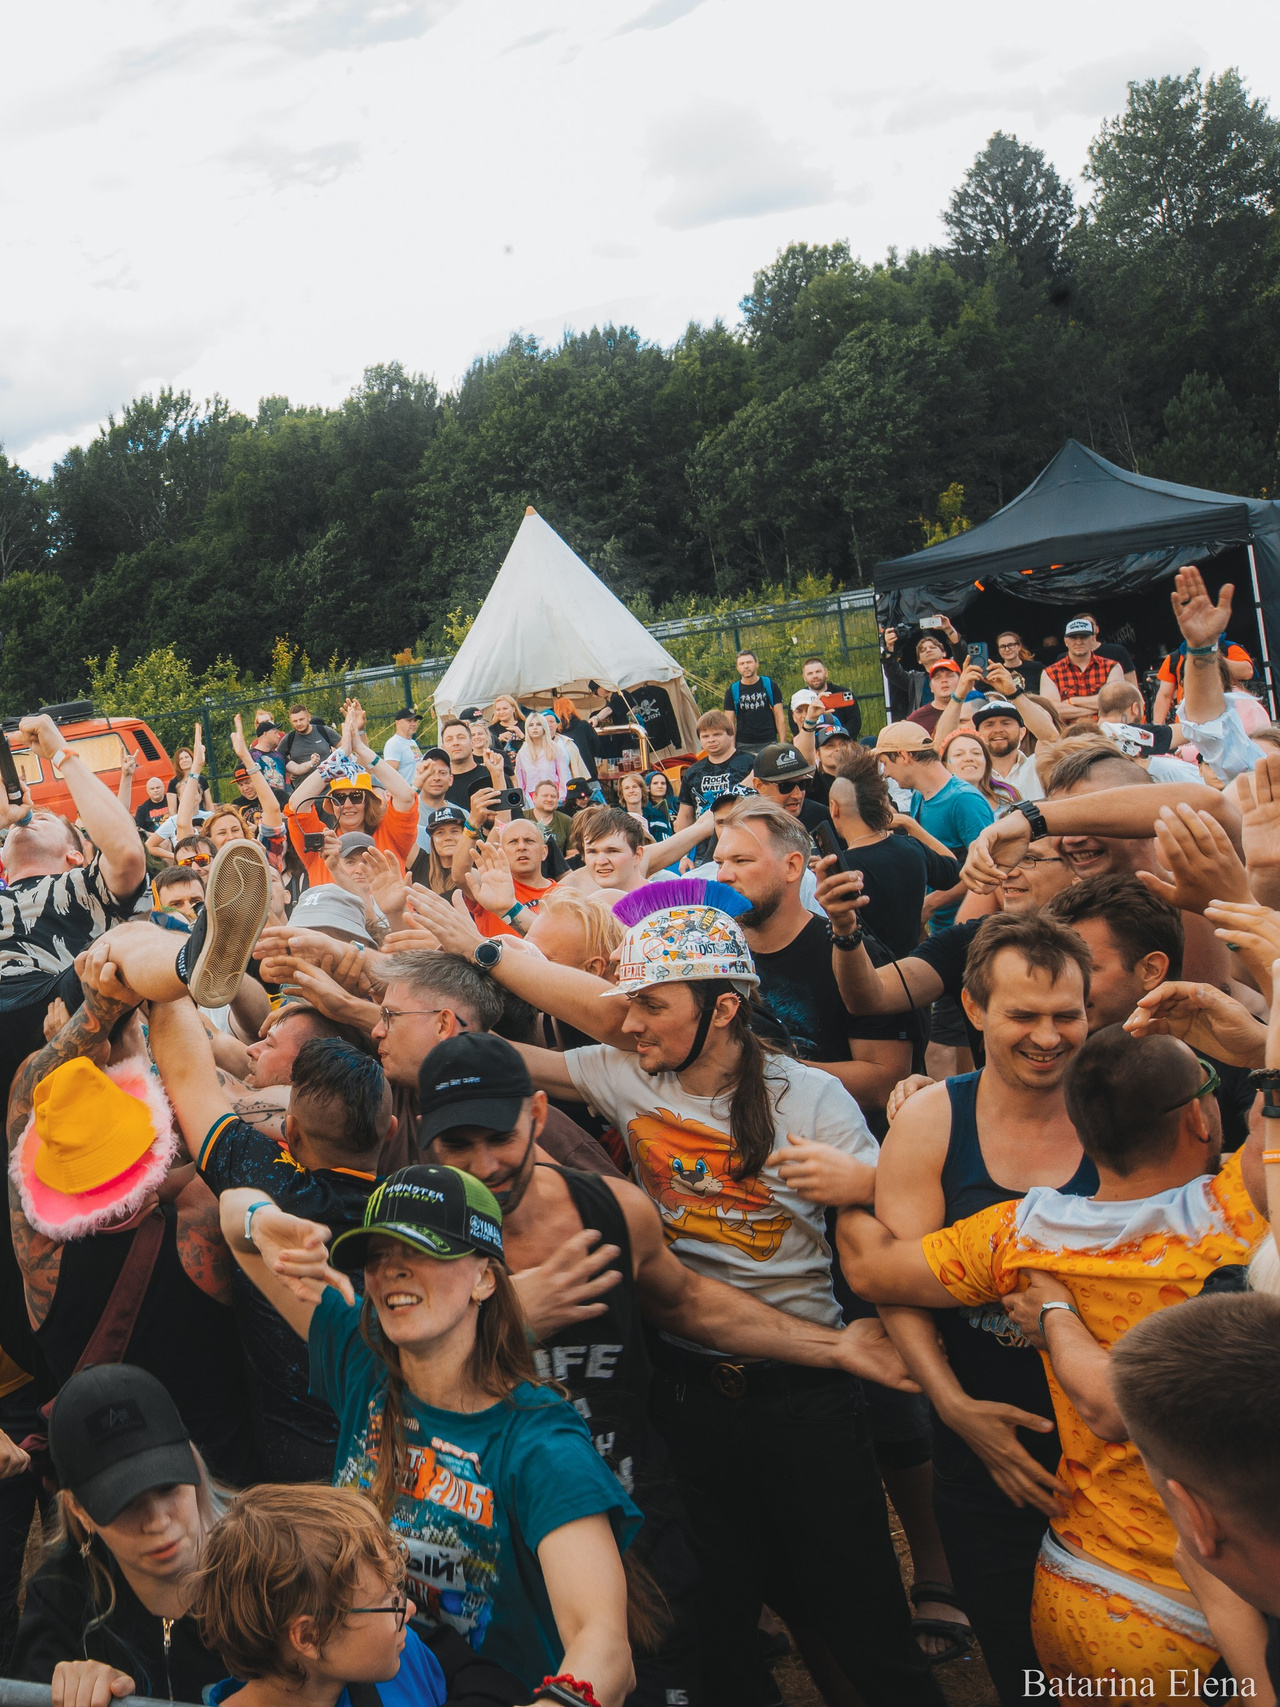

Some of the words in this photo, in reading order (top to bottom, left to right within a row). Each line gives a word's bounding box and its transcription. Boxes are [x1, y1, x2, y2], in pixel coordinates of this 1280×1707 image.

[703, 774, 729, 784] ROCK
[385, 1182, 445, 1202] MONSTER
[533, 1344, 624, 1379] IFE
[428, 1470, 487, 1522] 2015
